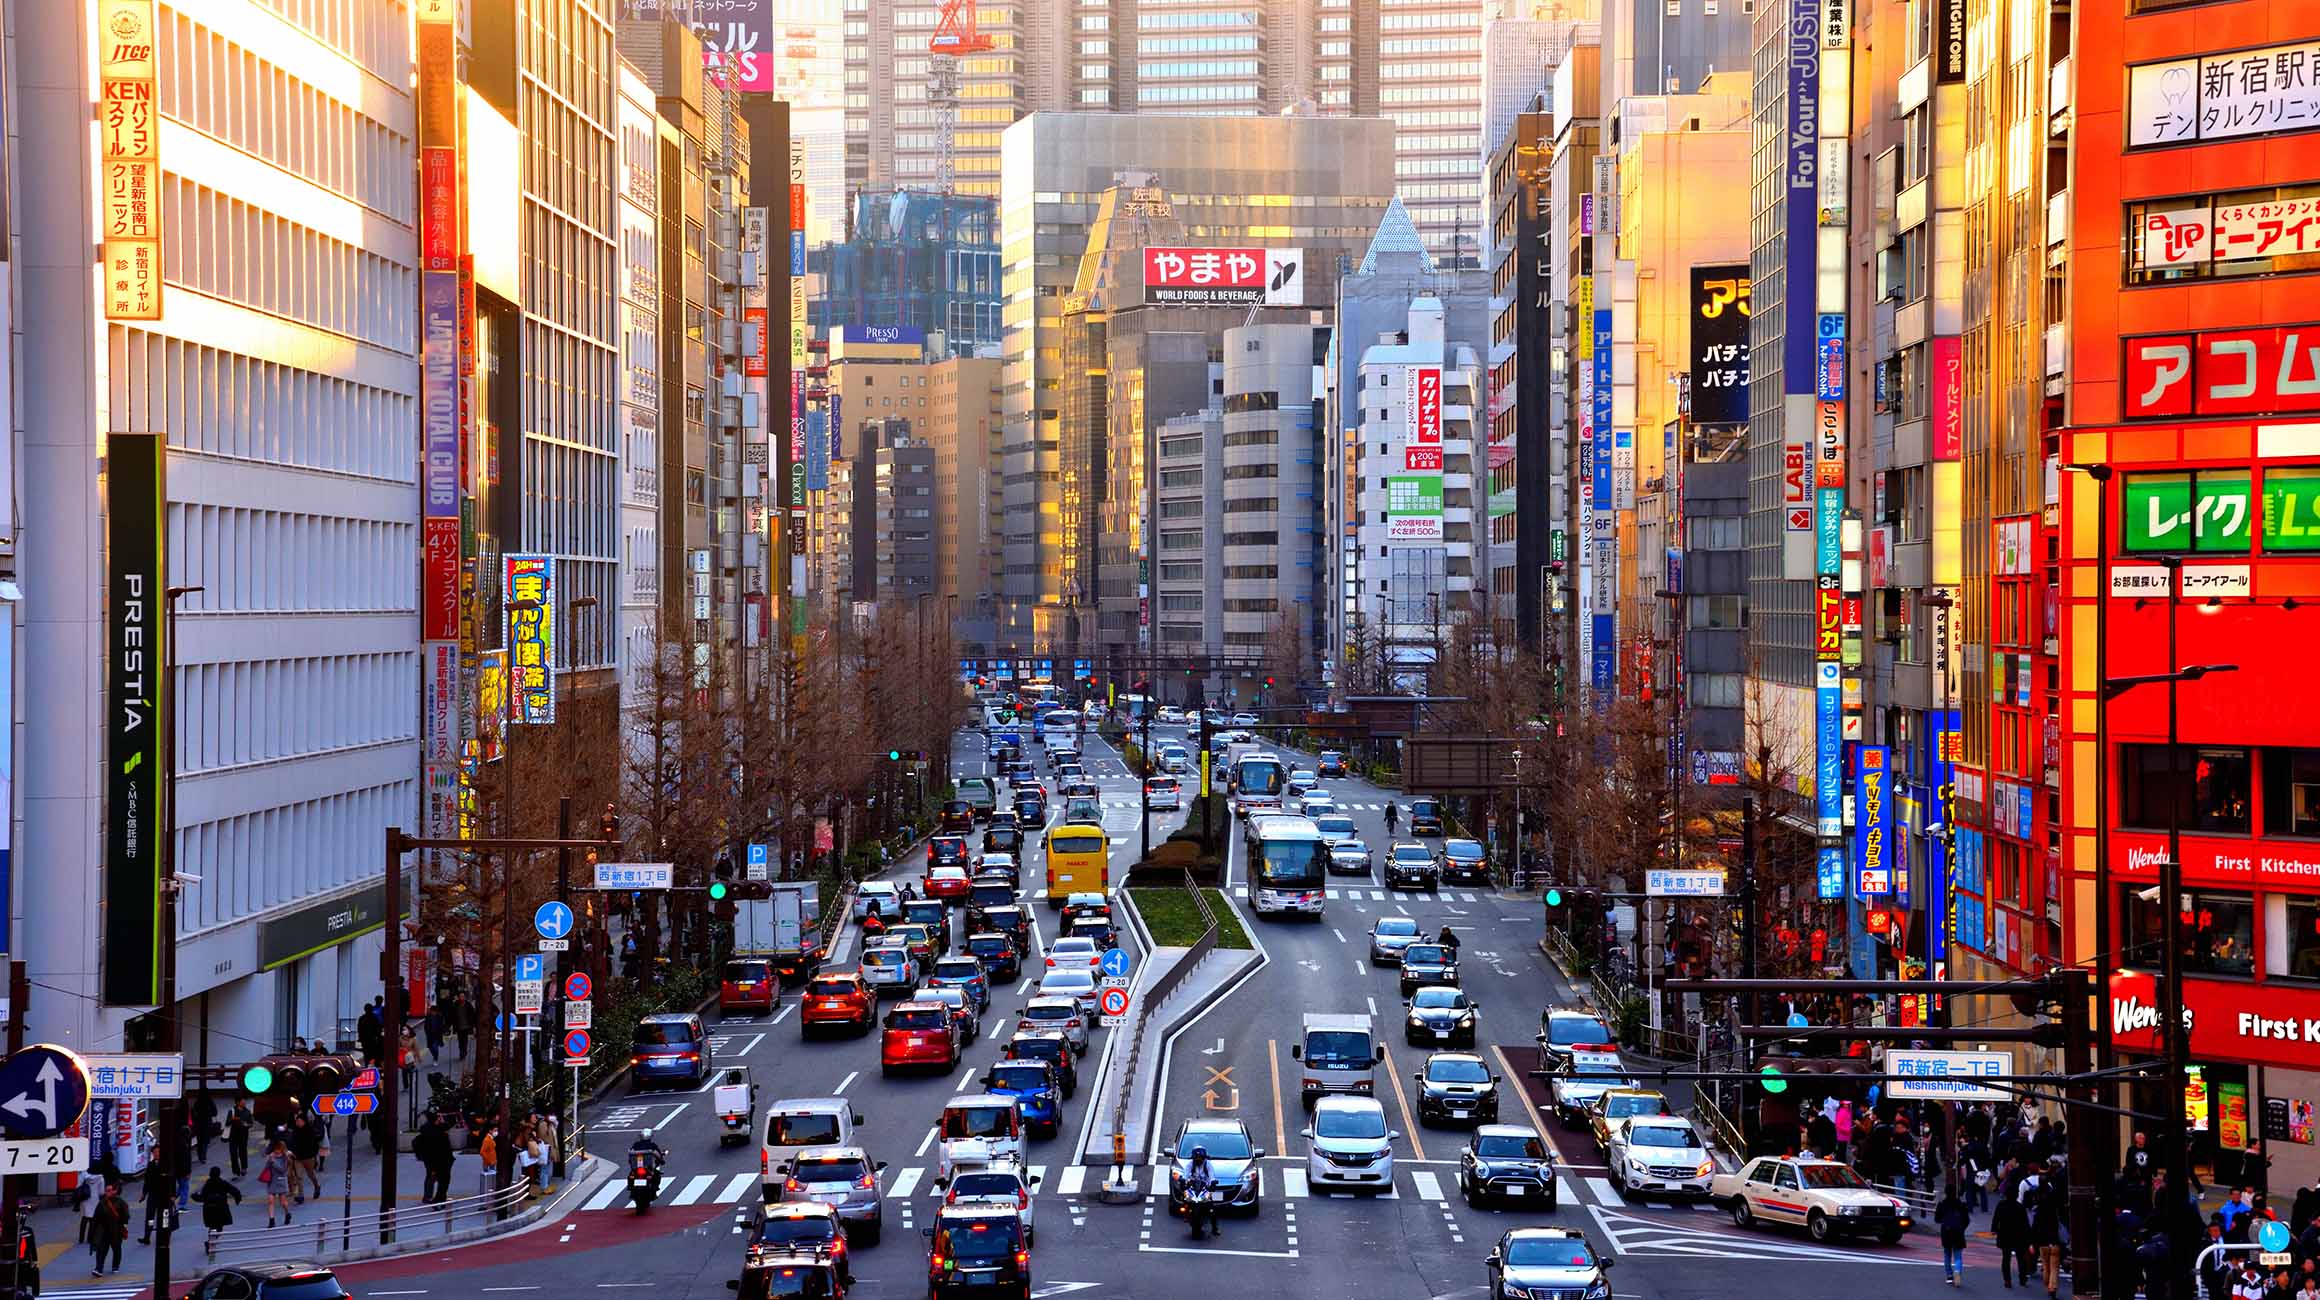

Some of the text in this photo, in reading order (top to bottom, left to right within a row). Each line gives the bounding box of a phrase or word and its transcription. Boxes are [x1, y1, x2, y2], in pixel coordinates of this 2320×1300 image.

[1950, 42, 1961, 73] ONE
[105, 82, 150, 100] KEN
[109, 101, 125, 156] スクール
[132, 101, 148, 156] パソコン
[1792, 98, 1815, 149] Your
[1791, 151, 1814, 188] For
[112, 163, 127, 235] クリニック
[431, 152, 448, 254] 品川美容外科
[431, 257, 449, 270] 6F
[1154, 252, 1256, 284] やまや
[1155, 290, 1257, 300] WORLD FOODS & BEVERAGE
[866, 327, 898, 340] PRESSO
[1819, 315, 1843, 337] 6F
[429, 312, 454, 505] JAPAN TOTAL CLUB
[1422, 376, 1438, 436] クリナップ
[1595, 331, 1612, 480] アートネイチャー
[1946, 360, 1960, 444] ワールドメイト
[1786, 446, 1804, 502] LABI
[1805, 463, 1813, 501] SHINJUKU
[437, 522, 458, 531] KEN
[1595, 519, 1611, 530] 6F
[2149, 495, 2247, 537] レイク
[442, 533, 457, 637] パソコンスクール
[1820, 577, 1839, 589] 3F
[2184, 575, 2249, 587] エーアイアール
[1821, 592, 1839, 649] トレカ
[530, 695, 549, 708] 3F
[1864, 751, 1883, 769] 薬
[1863, 772, 1882, 868] マツモトキヨシ
[2215, 855, 2252, 871] First
[1104, 978, 1126, 986] 7-20
[2238, 1012, 2299, 1040] First
[88, 1066, 173, 1084] 宿1丁目
[1898, 1059, 2001, 1077] 西新宿一丁目
[146, 1085, 151, 1094] 1
[1903, 1080, 1979, 1093] Nishishinjuku
[336, 1098, 354, 1110] 414
[92, 1113, 104, 1139] BOSS
[116, 1098, 132, 1149] IRIN
[7, 1144, 74, 1168] 7-20
